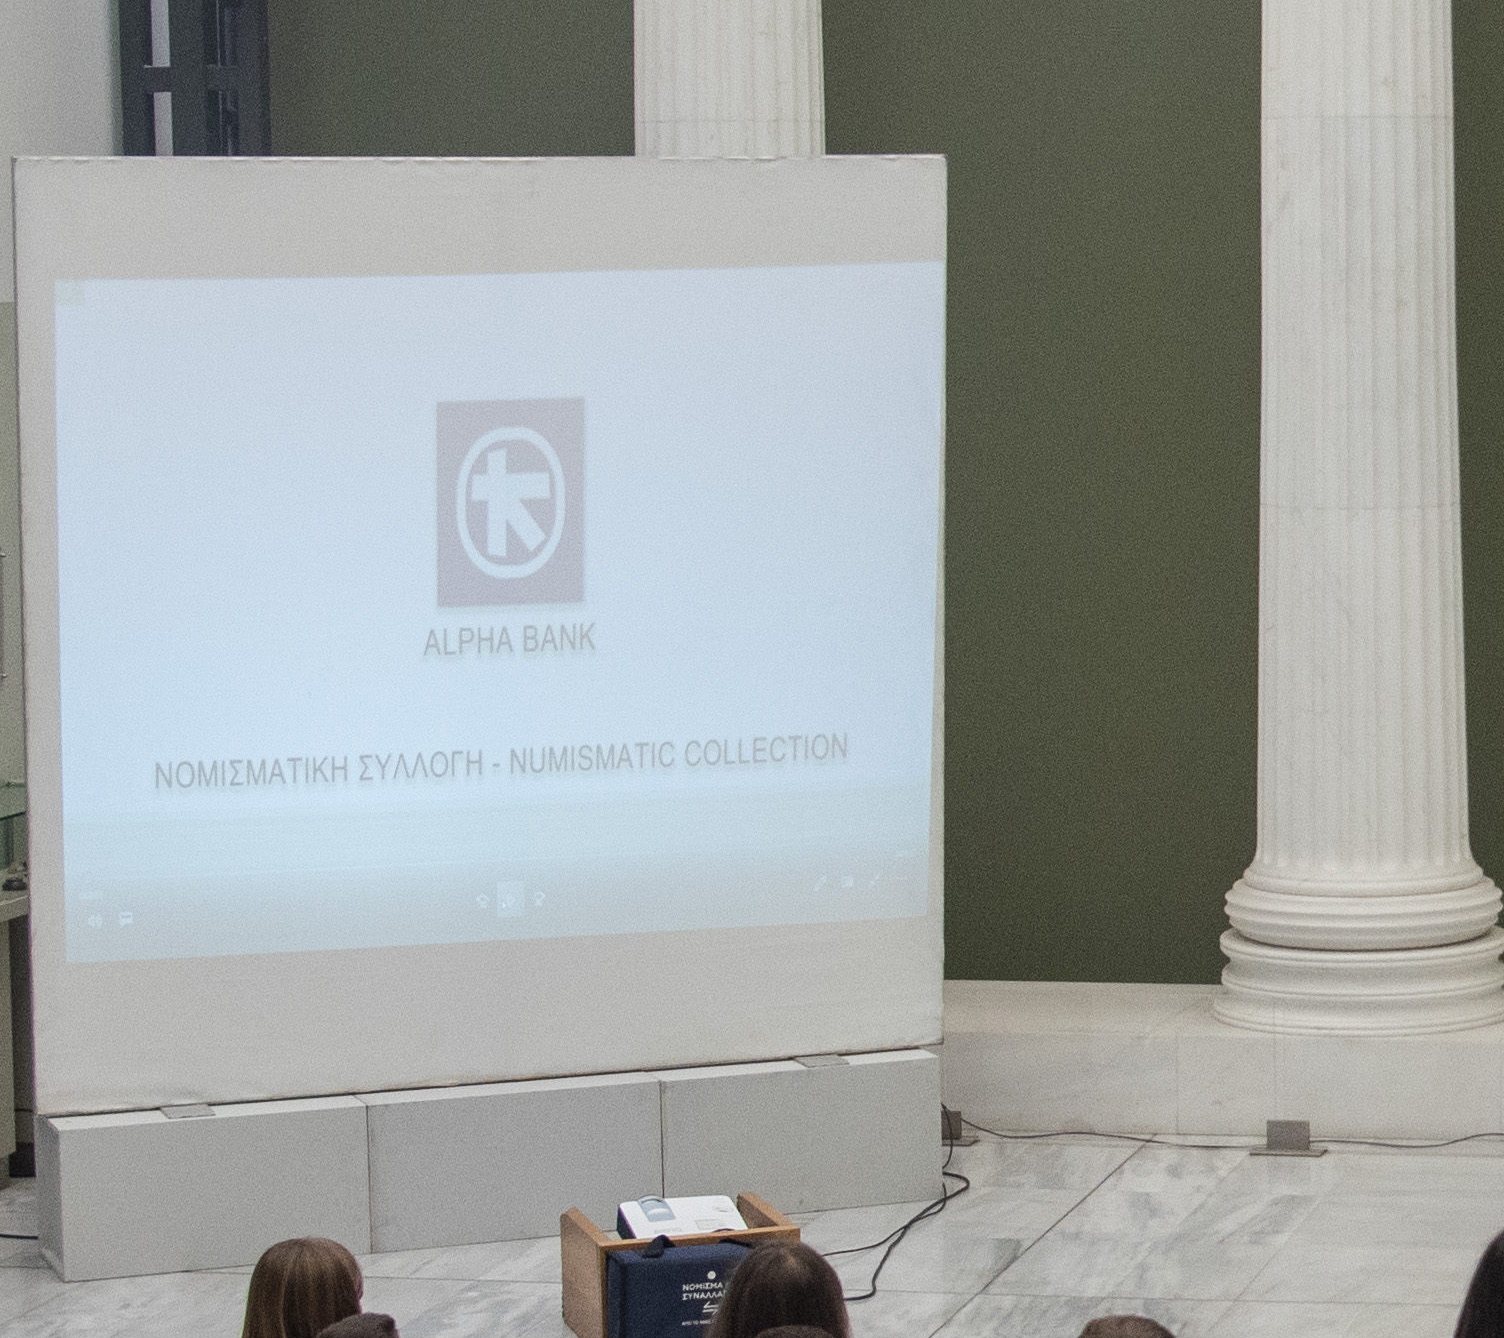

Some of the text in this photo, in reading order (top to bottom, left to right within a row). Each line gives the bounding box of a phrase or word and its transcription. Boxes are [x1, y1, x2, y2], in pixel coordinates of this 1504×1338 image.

[423, 621, 596, 656] ALPHA BANK
[154, 755, 348, 789] ΝΟΜΙΣΜΑΤΙΚΗ
[358, 748, 483, 782] ΣΥΛΛΟΓΗ
[509, 740, 676, 774] NUMISMATIC
[684, 731, 849, 768] COLLECTION
